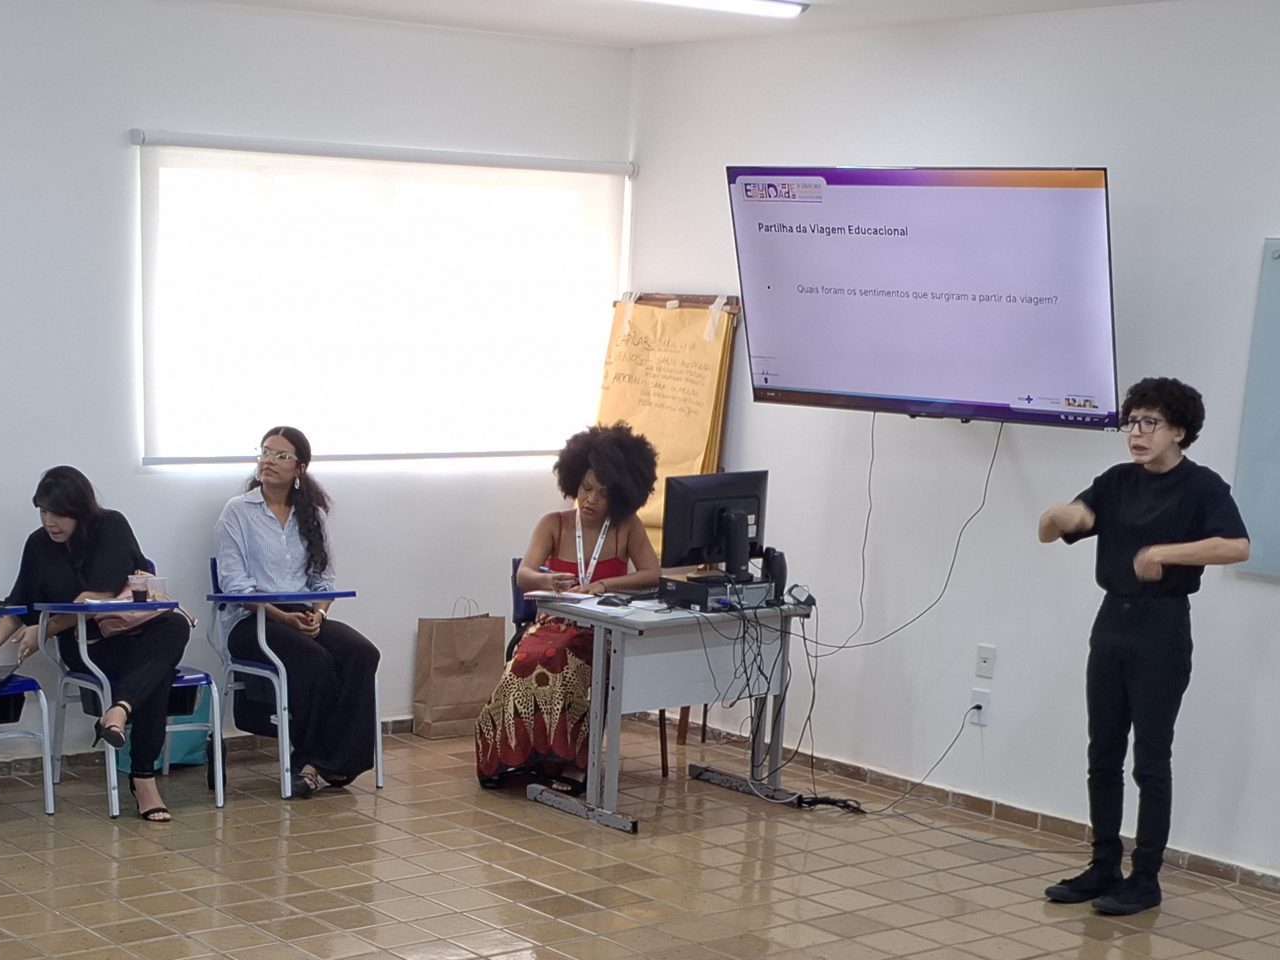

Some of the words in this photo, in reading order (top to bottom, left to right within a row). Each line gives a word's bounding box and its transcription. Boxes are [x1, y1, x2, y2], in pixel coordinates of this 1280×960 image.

[758, 222, 794, 233] Partilha
[795, 223, 807, 234] da
[808, 223, 846, 236] Viagem
[848, 225, 908, 236] Educacional
[796, 284, 819, 294] Quais
[821, 285, 845, 295] foram
[847, 288, 857, 296] os
[859, 288, 910, 298] sentimentos
[912, 291, 928, 300] que
[931, 291, 969, 302] surgiram
[971, 294, 977, 302] a
[979, 293, 1003, 304] partir
[1005, 294, 1017, 304] da
[1019, 294, 1058, 306] viagem?
